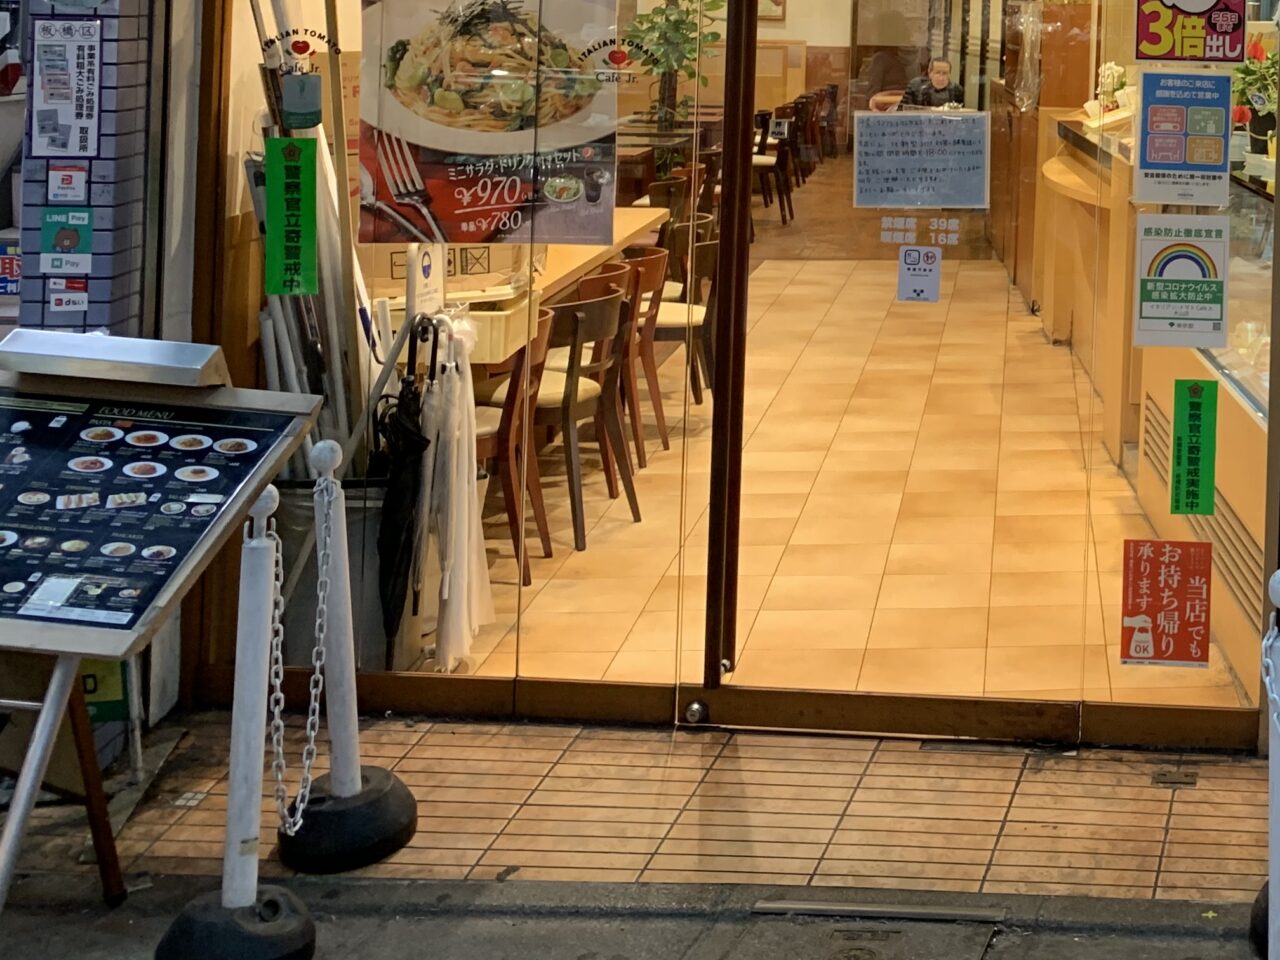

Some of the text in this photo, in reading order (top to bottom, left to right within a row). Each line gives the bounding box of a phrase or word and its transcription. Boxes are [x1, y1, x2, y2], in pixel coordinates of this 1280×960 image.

[304, 28, 341, 55] TOMATO
[577, 38, 660, 65] ITALIAN TOMATO
[454, 175, 521, 207] ¥970
[46, 213, 87, 223] LINE Pay
[1136, 543, 1155, 612] 承ります
[1157, 543, 1181, 658] お持ち帰り
[1184, 576, 1208, 658] 当店でも
[1134, 644, 1150, 654] OK
